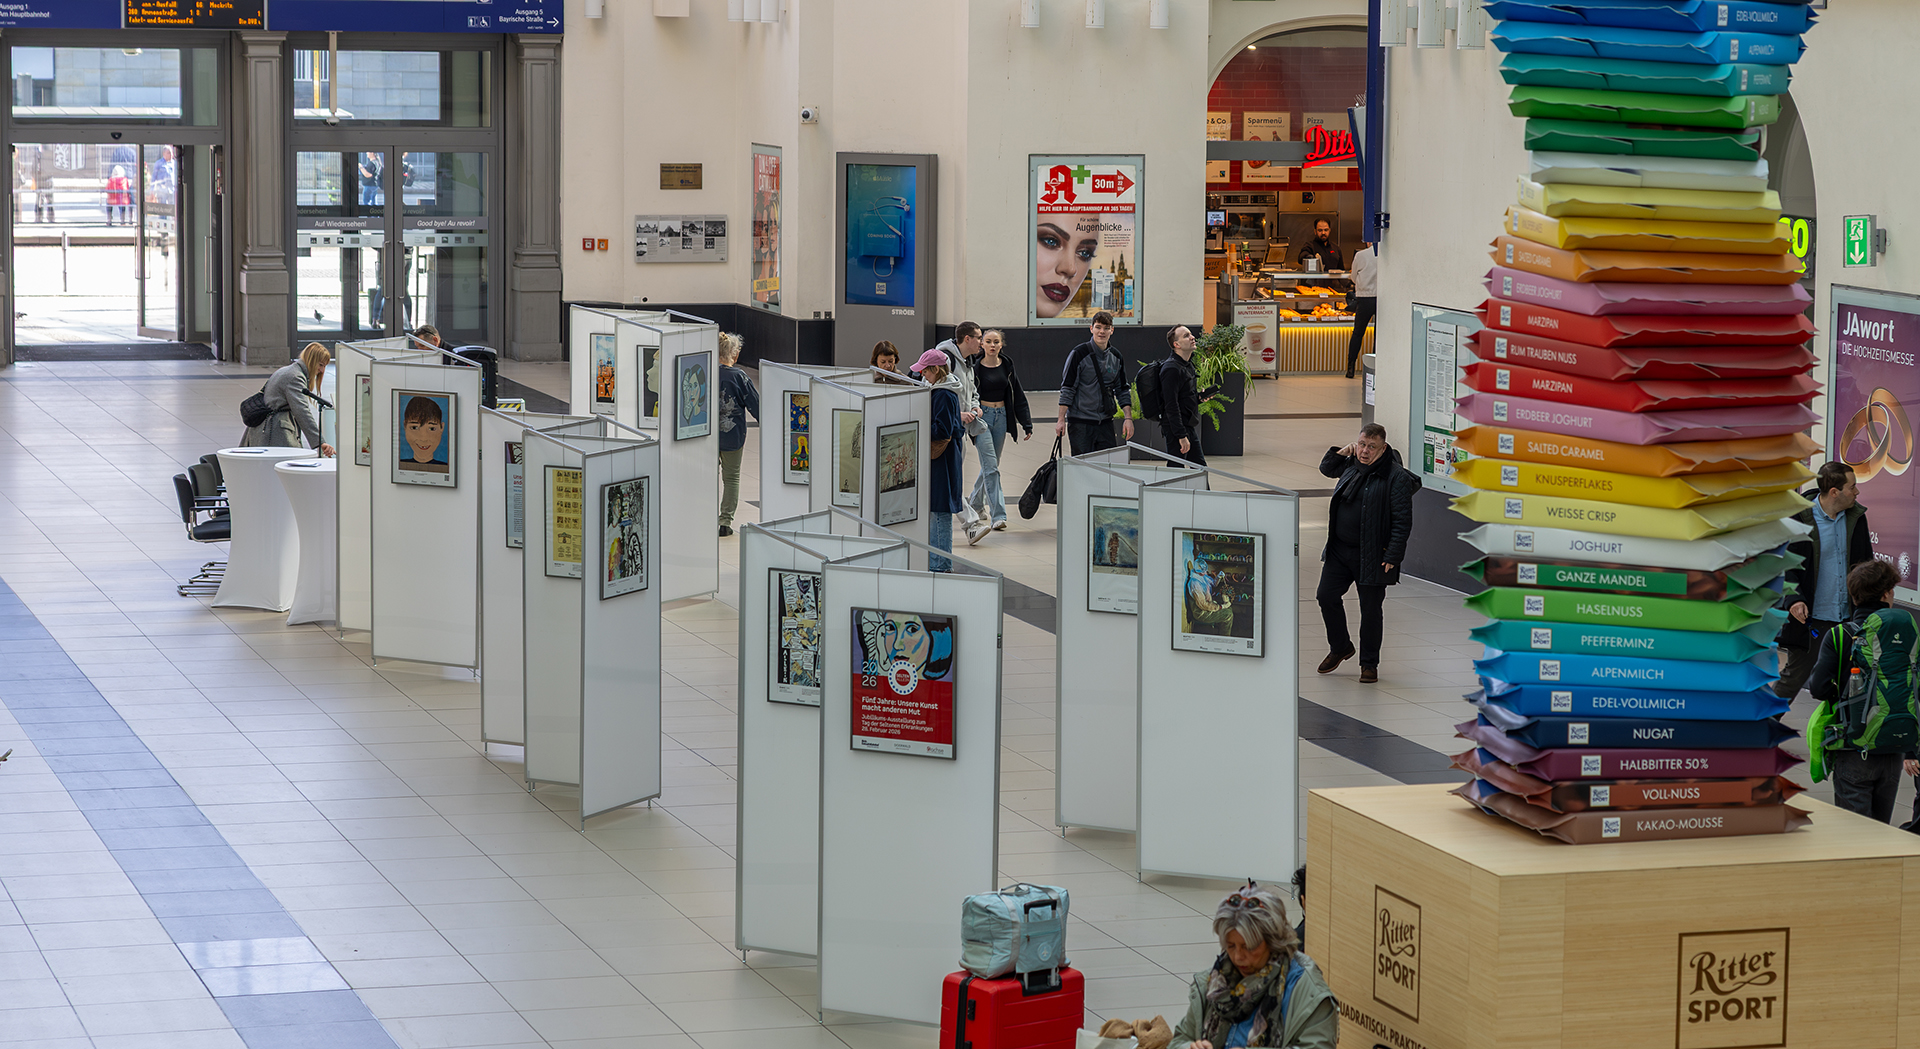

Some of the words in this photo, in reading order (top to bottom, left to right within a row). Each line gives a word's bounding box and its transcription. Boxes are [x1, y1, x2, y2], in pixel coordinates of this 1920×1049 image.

[1248, 116, 1282, 126] Sparmenü
[1306, 116, 1324, 124] Pizza
[433, 220, 446, 228] bye!
[1076, 223, 1122, 233] Augenblicke
[1516, 282, 1536, 296] ERDBEER
[1537, 287, 1563, 300] JOGHURT
[891, 308, 915, 316] STRÖER
[1527, 315, 1559, 329] MARZIPAN
[1842, 312, 1894, 343] JAwort
[1510, 344, 1525, 356] RUM
[1527, 347, 1557, 361] TRAUBEN
[1558, 352, 1577, 364] NUSS
[1842, 342, 1852, 356] DIE
[1853, 344, 1915, 366] HOCHZEITSMESSE
[1532, 379, 1573, 394] MARZIPAN
[1516, 409, 1550, 423] ERDBEER
[1551, 414, 1593, 428] JOGHURT
[1528, 441, 1559, 455] SALTED
[1560, 446, 1605, 460] CARAMEL
[1535, 474, 1613, 491] KNUSPERFLAKES
[1546, 506, 1584, 520] WEISSE
[1587, 510, 1616, 522] CRISP
[1569, 540, 1623, 554] JOGHURT
[1556, 570, 1596, 583] GANZE
[1599, 574, 1647, 587] MANDEL
[1577, 604, 1643, 617] HASELNUSS
[1581, 635, 1654, 649] PFEFFERMINZ
[862, 661, 877, 672] 20
[1592, 667, 1664, 680] ALPENMILCH
[862, 675, 877, 686] 26
[1592, 697, 1685, 709] EDEL-VOLLMILCH
[901, 724, 933, 732] Erkrankungen
[1633, 728, 1675, 739] NUGAT
[1620, 759, 1682, 770] HALBBITTER
[1685, 758, 1709, 770] 50%
[1642, 788, 1700, 800] VOLL-NUSS
[1637, 817, 1724, 831] KAKAO-MOUSSE
[1378, 908, 1416, 957] Ritter
[1378, 953, 1416, 991] SPORT
[1689, 951, 1777, 996] Ritter
[1688, 996, 1777, 1024] SPORT
[1340, 1001, 1389, 1041] UADRATISCH.
